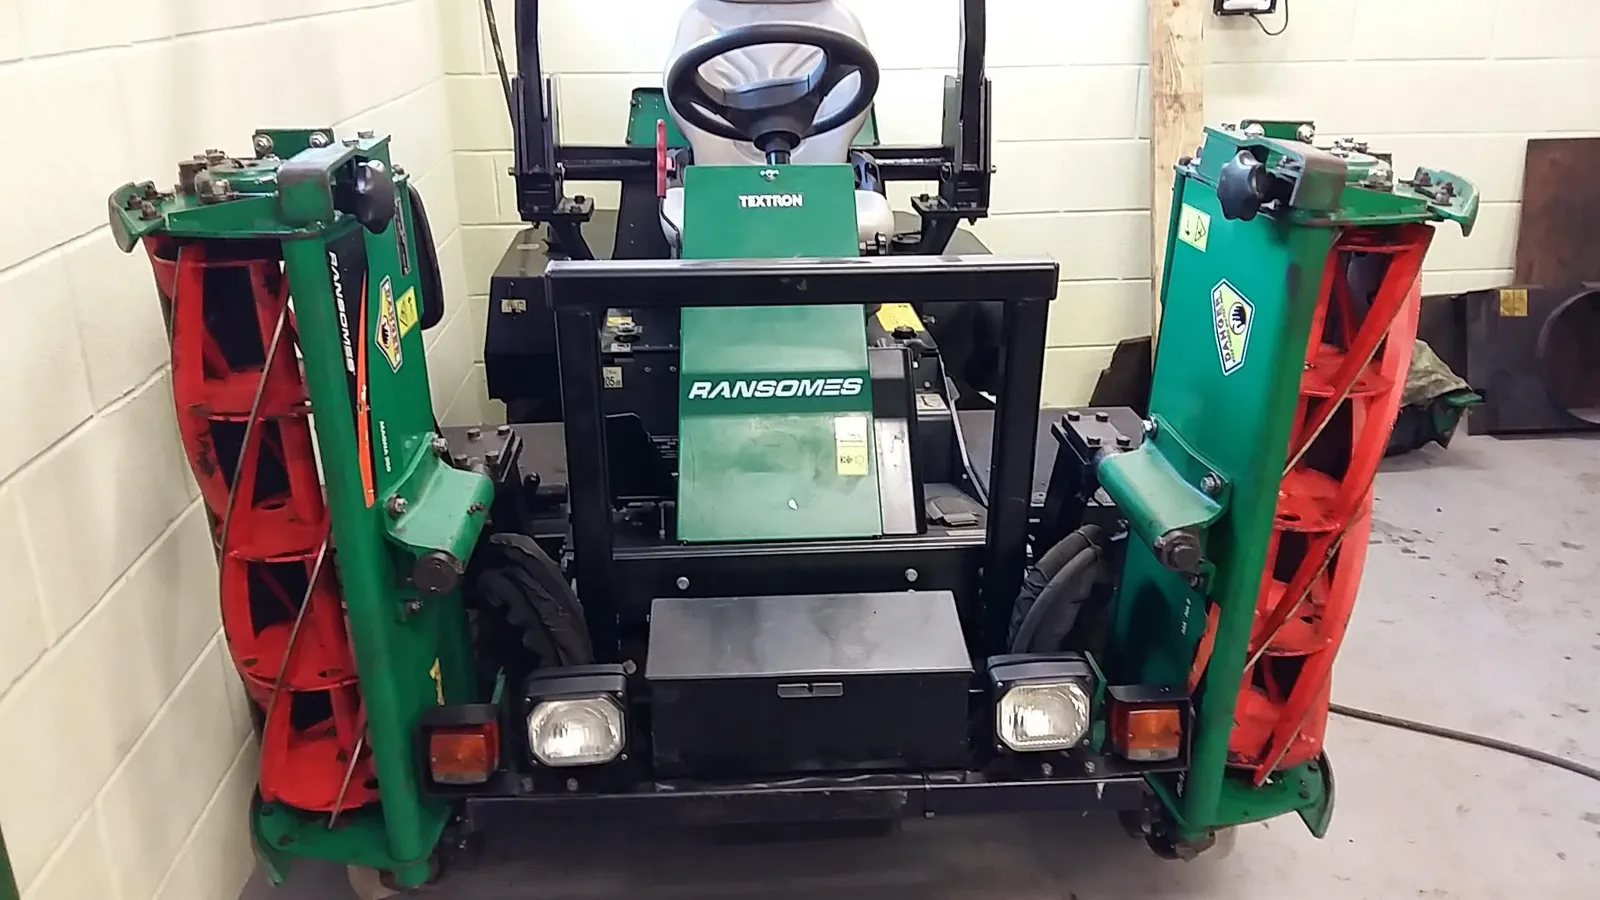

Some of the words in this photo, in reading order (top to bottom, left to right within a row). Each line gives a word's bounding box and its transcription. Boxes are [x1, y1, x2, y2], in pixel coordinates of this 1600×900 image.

[738, 194, 803, 208] TEXTRON
[328, 251, 356, 375] RANSOMES
[688, 378, 864, 399] RANSOMES
